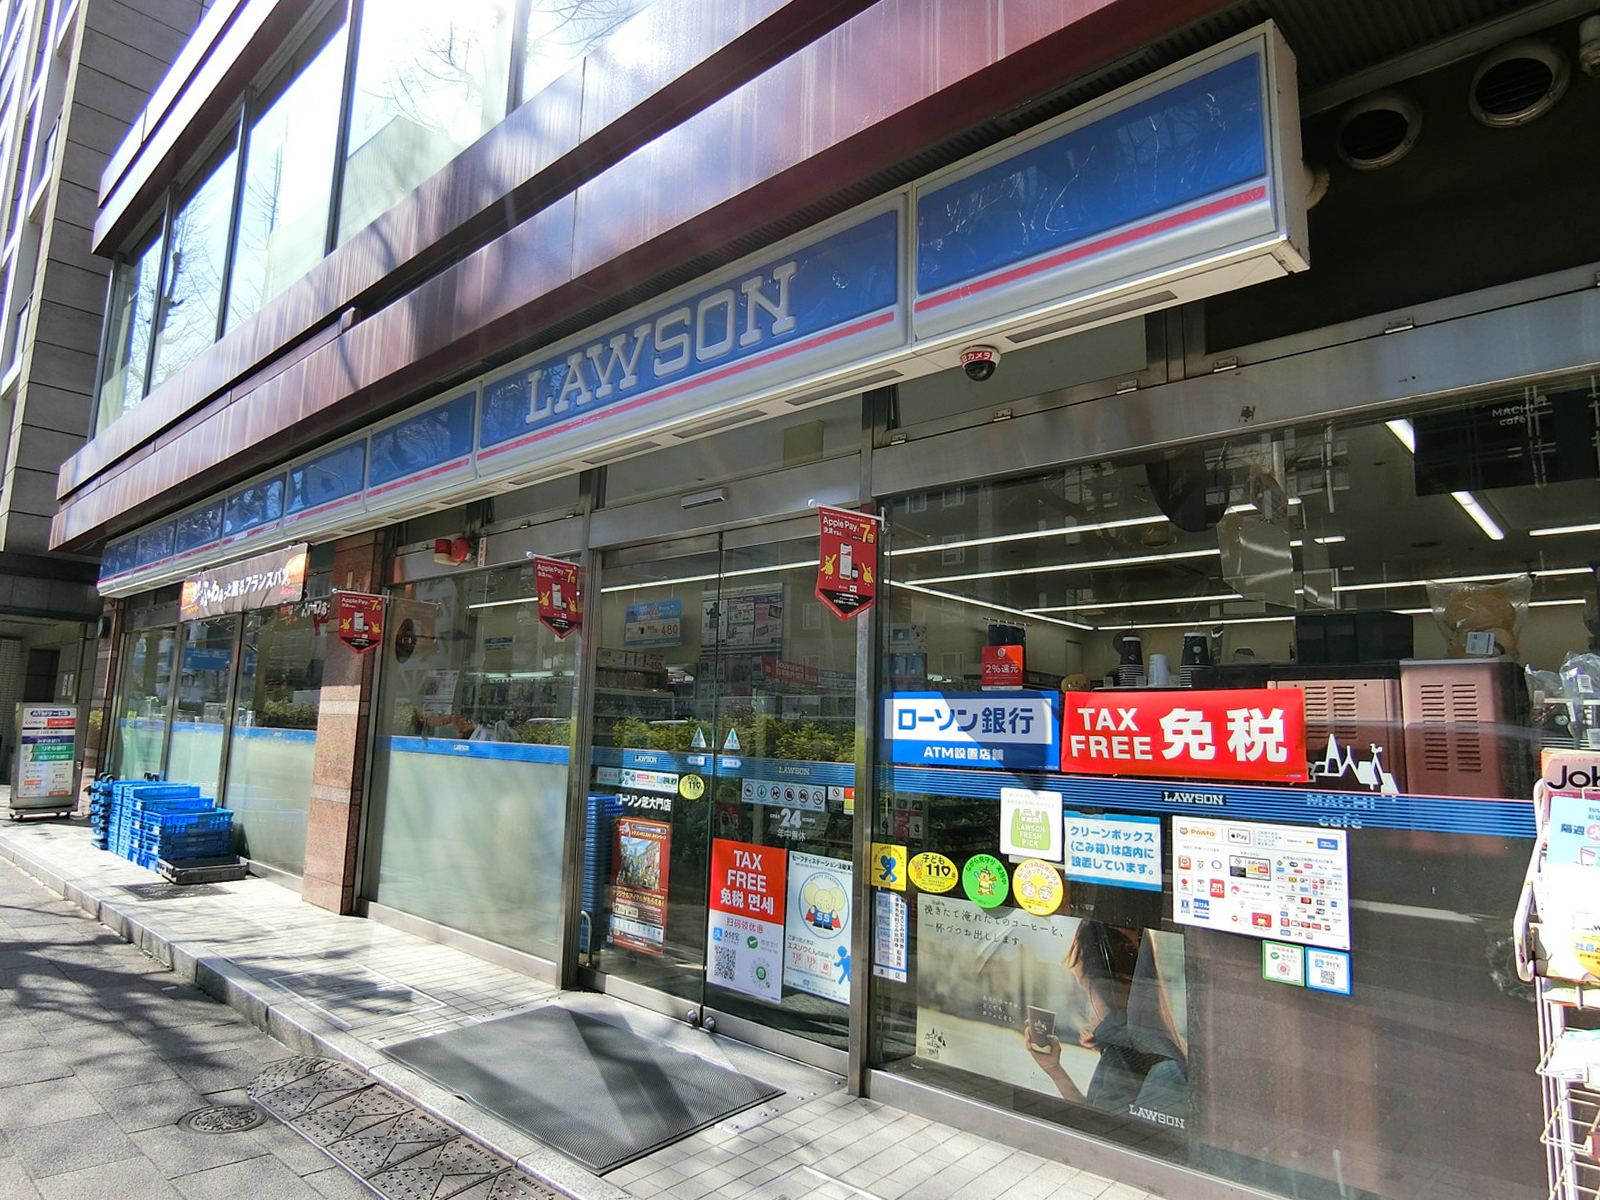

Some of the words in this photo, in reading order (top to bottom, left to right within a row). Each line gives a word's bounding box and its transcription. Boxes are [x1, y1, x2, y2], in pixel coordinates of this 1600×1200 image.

[525, 261, 798, 424] LAWSON
[844, 520, 858, 532] Pay
[898, 706, 1034, 735] ローソン銀行
[1076, 707, 1140, 732] TAX
[1158, 707, 1289, 763] 免税
[923, 746, 1004, 761] ATM設置店舗
[1069, 735, 1154, 761] FREE
[779, 766, 811, 776] LAWSON
[1163, 791, 1225, 806] LAWSON
[1306, 792, 1377, 810] MACHI
[780, 807, 802, 829] 24
[1016, 823, 1045, 833] LAWSON
[1019, 831, 1042, 840] FRESH
[1070, 826, 1155, 844] クリーンボックス
[1190, 827, 1217, 838] Ponta
[733, 849, 763, 871] TAX
[922, 853, 945, 865] 子ども
[1070, 840, 1155, 860] (ごみ箱)は店内に
[1070, 855, 1155, 877] 設置しています。
[726, 869, 767, 893] FREE
[720, 886, 745, 910] 免税
[748, 893, 775, 916] 면세
[816, 912, 831, 923] SS
[1128, 1104, 1186, 1129] LAWSON
